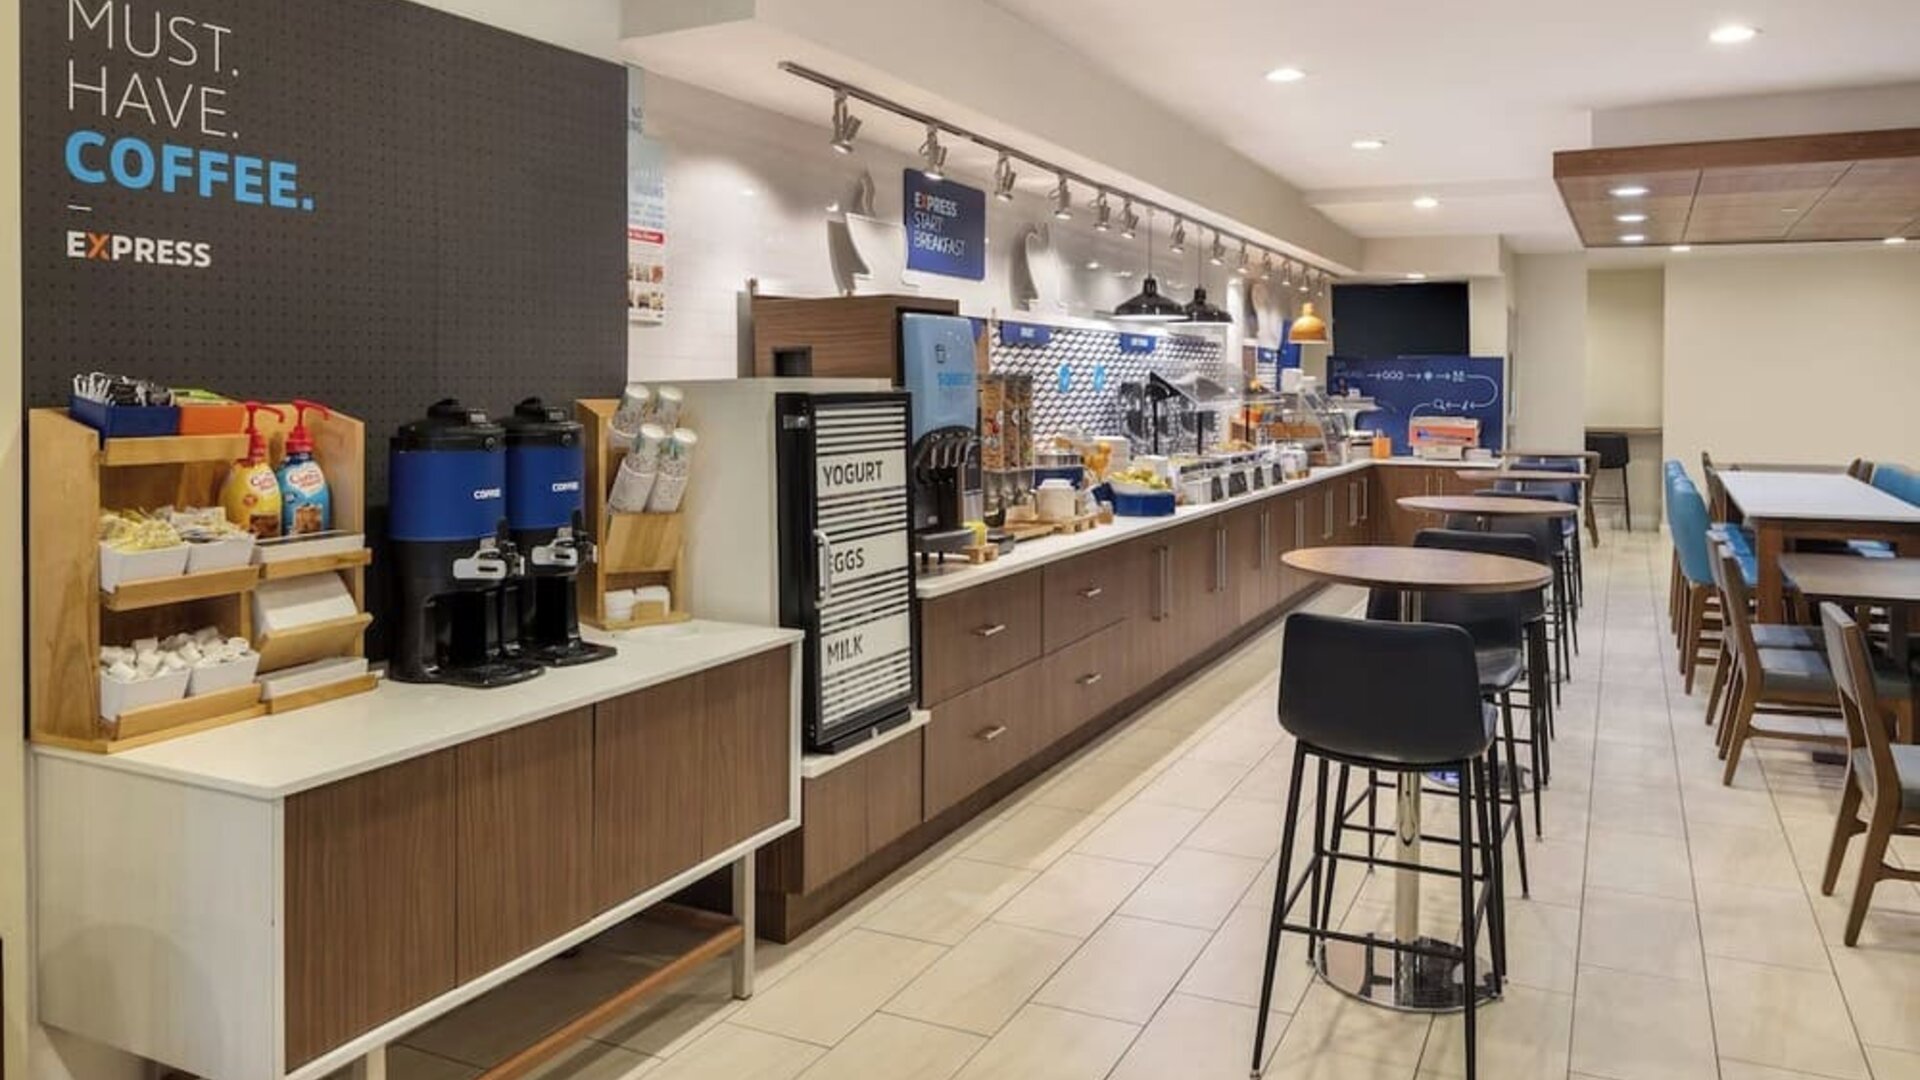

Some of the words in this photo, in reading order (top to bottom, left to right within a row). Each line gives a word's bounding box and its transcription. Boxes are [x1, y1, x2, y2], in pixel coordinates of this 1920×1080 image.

[68, 0, 239, 77] MUST.
[68, 59, 239, 140] HAVE.
[64, 129, 314, 211] COFFEE.
[914, 192, 958, 217] EXPRESS
[66, 230, 212, 268] EXPRESS
[822, 461, 883, 487] YOGURT
[827, 635, 863, 664] MILK
